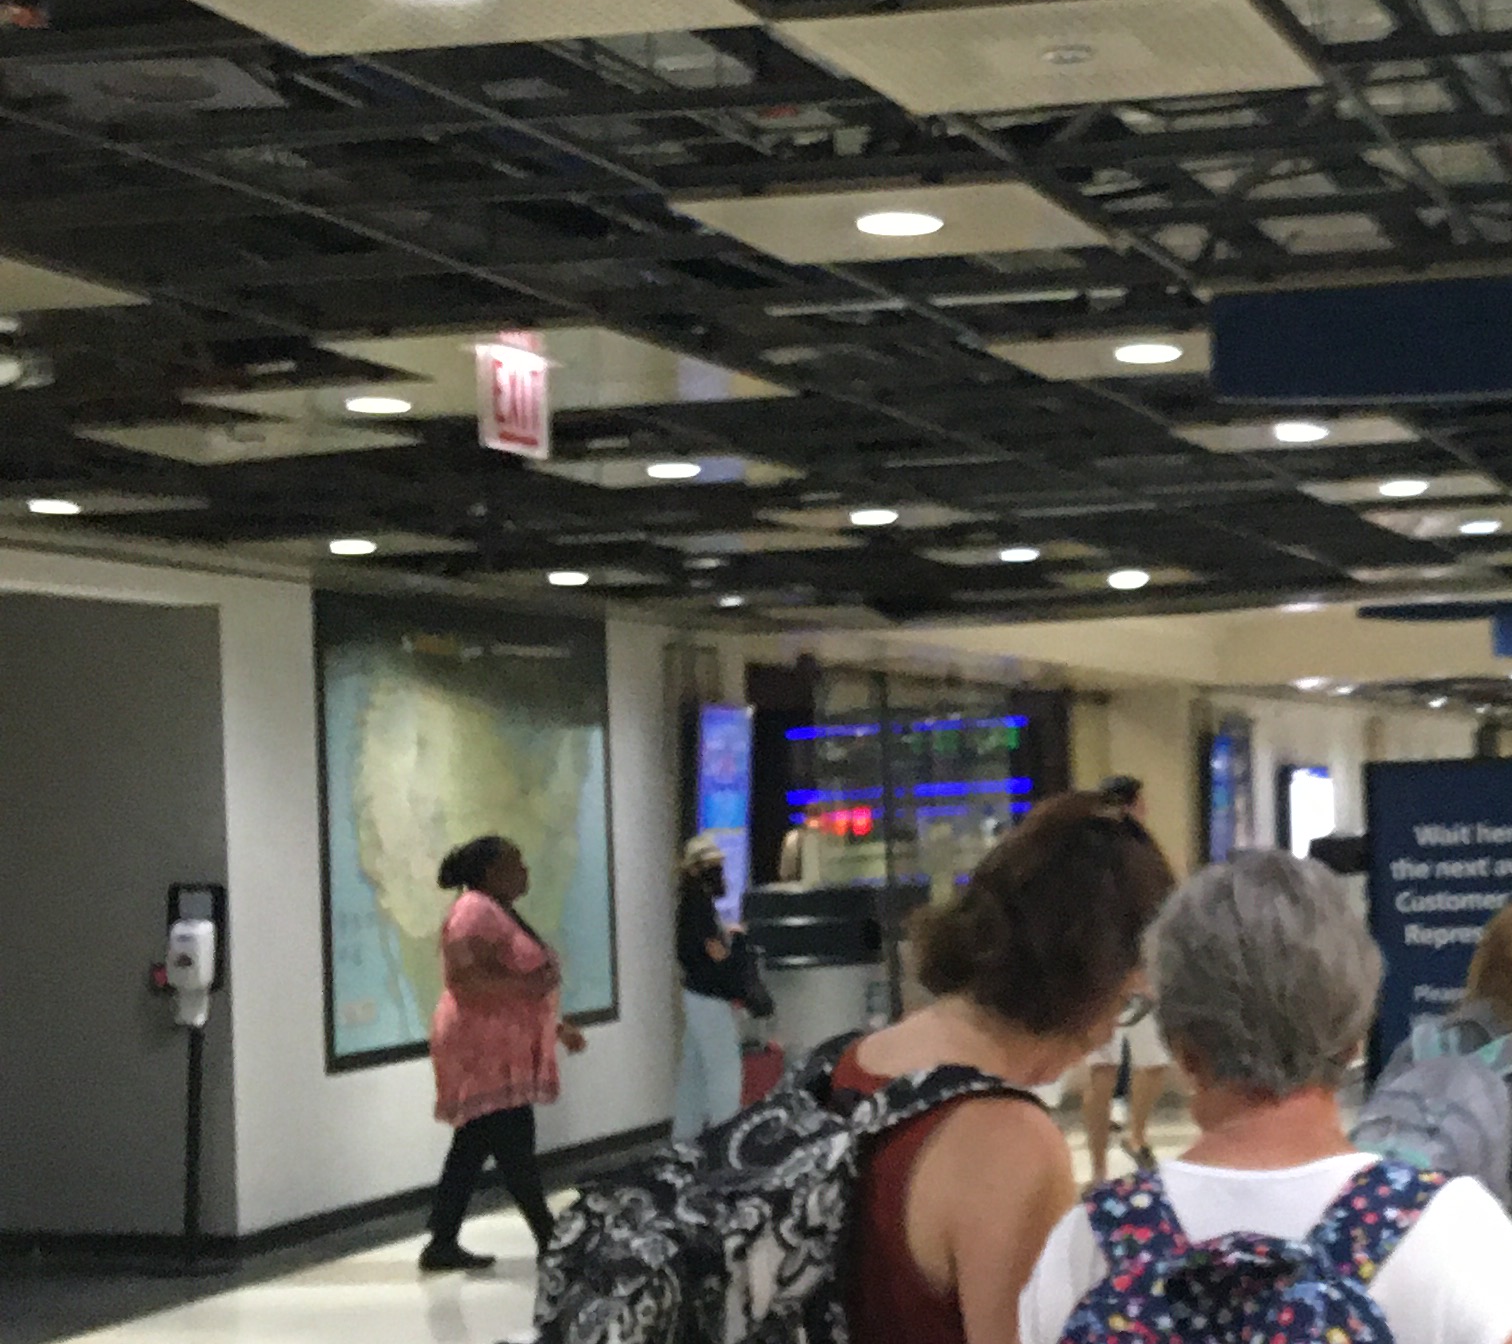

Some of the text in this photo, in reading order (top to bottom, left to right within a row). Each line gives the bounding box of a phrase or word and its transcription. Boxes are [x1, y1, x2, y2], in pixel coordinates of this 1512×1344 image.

[1413, 822, 1470, 846] Wait
[1389, 858, 1431, 881] the
[1434, 857, 1490, 879] next
[1396, 891, 1510, 913] Customer
